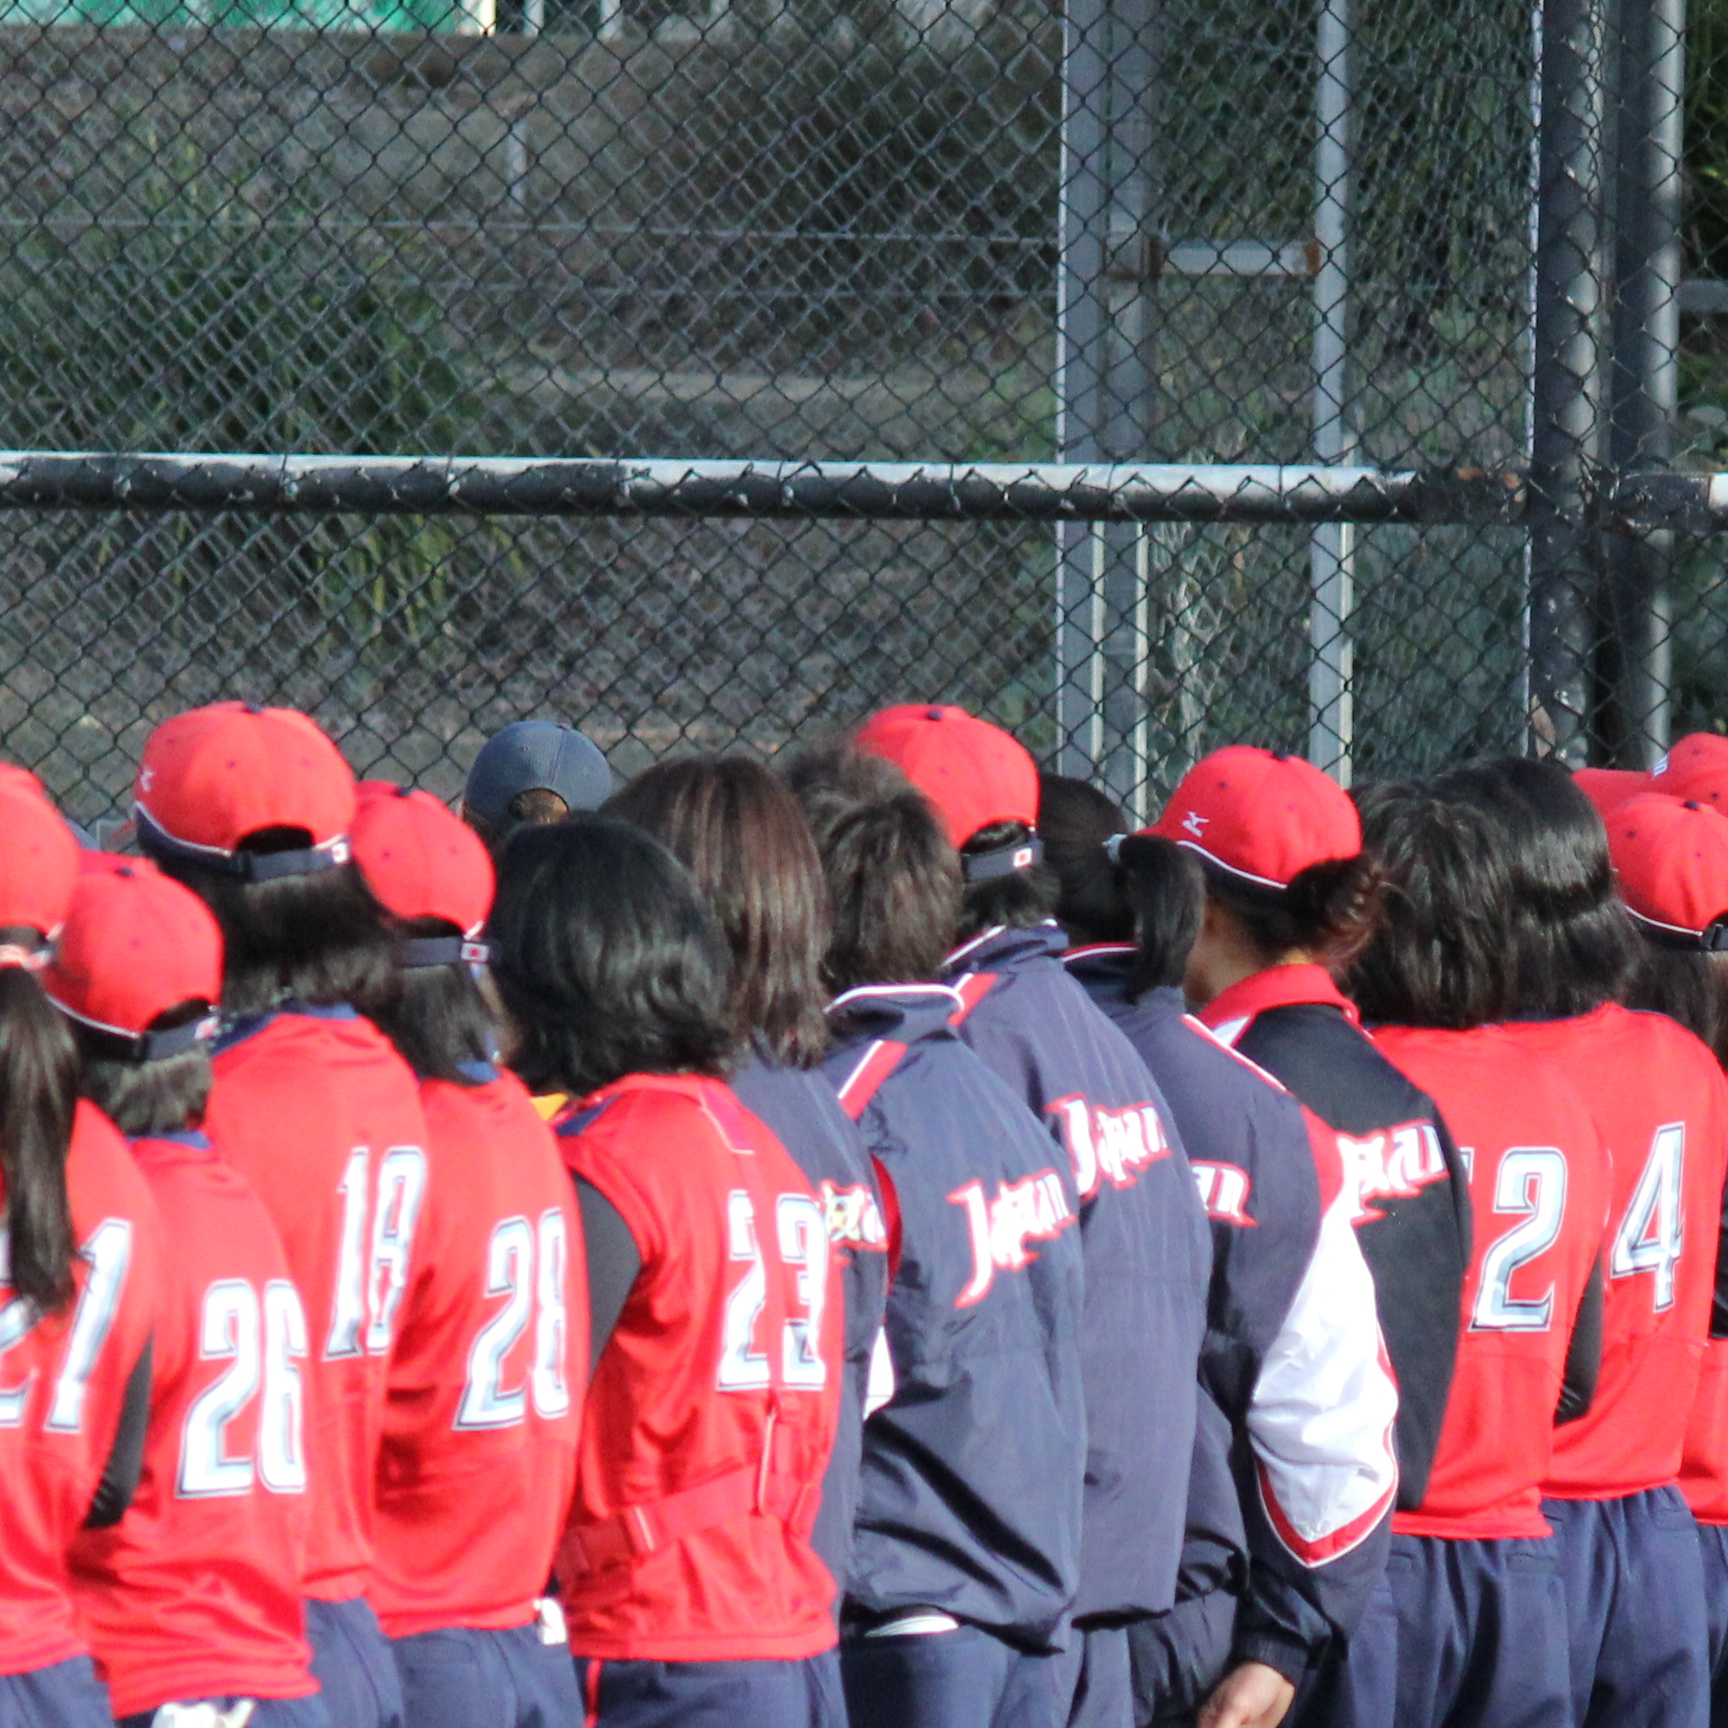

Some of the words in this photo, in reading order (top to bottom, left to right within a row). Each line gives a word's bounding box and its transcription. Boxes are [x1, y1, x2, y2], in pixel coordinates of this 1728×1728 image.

[946, 1167, 1079, 1310] Japan
[1045, 1092, 1173, 1199] Japan
[1610, 1121, 1685, 1314] 4
[321, 1145, 427, 1361] 18
[716, 1188, 829, 1392] 23
[176, 1278, 308, 1499] 26
